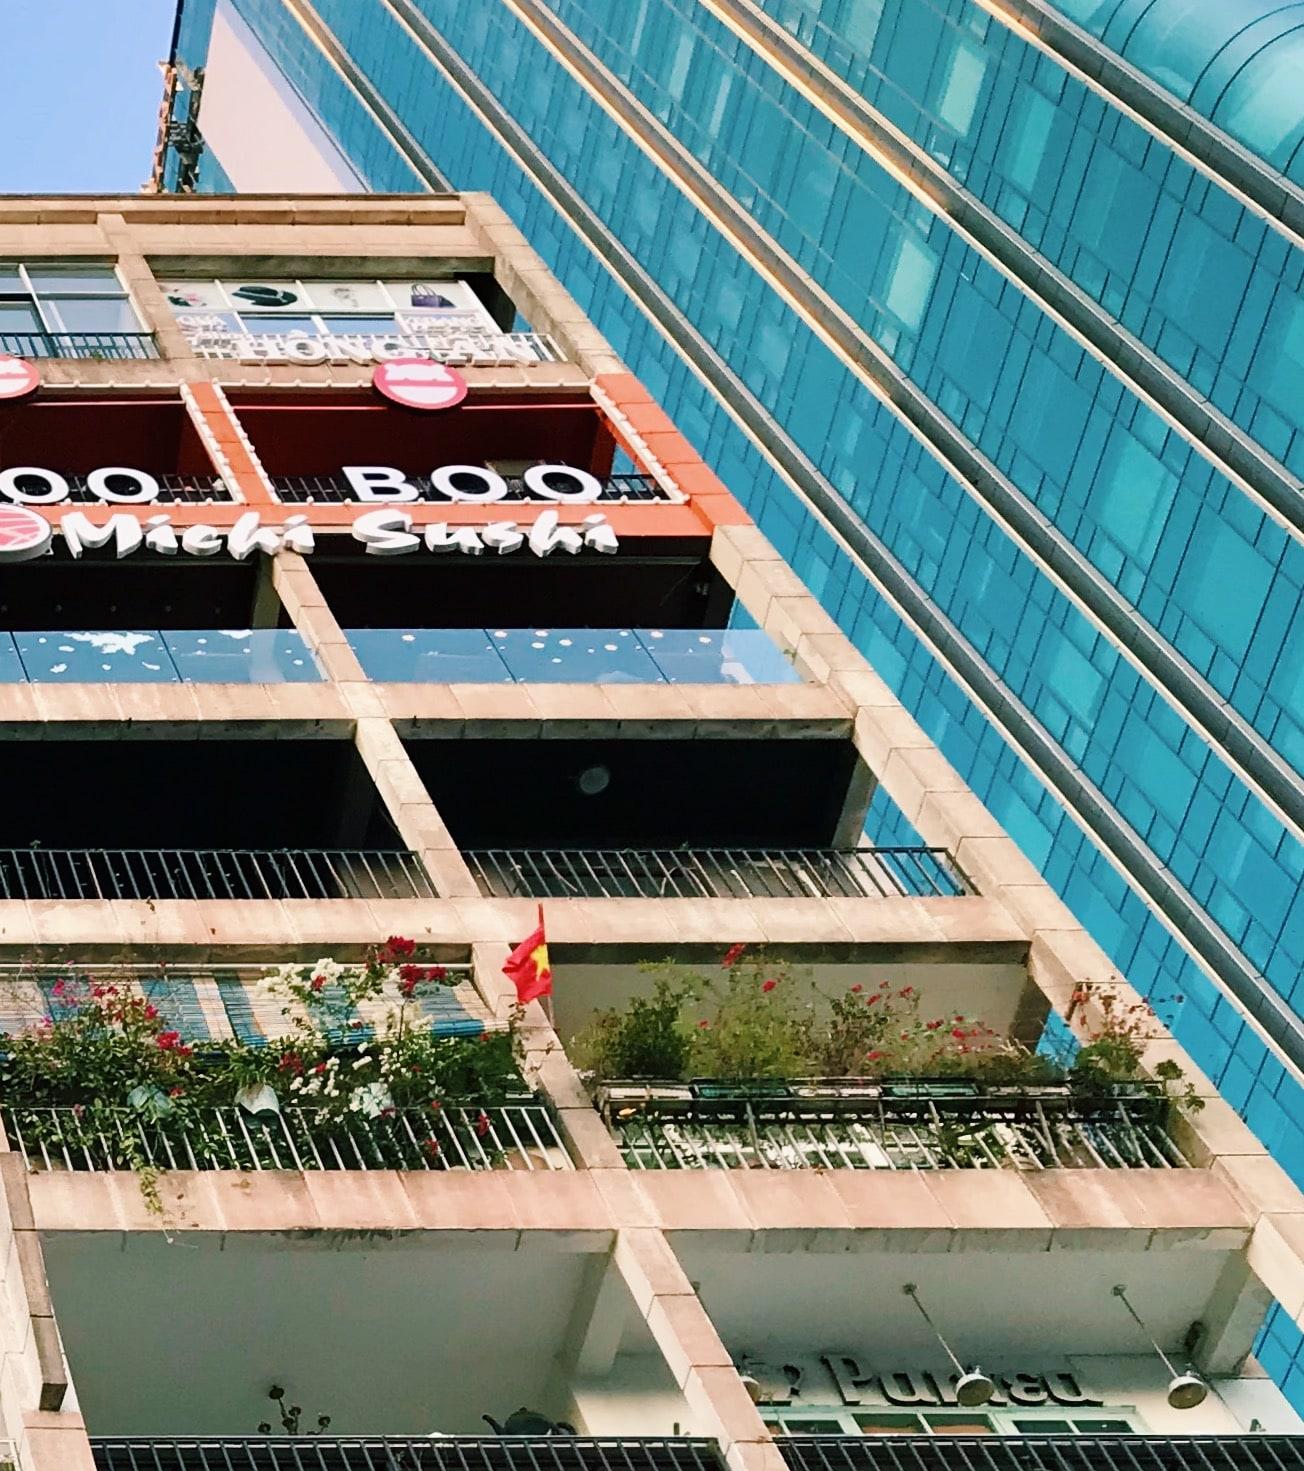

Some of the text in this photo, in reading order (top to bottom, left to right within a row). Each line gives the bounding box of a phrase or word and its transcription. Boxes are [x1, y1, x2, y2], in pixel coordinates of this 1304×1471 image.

[341, 464, 603, 504] BOO
[60, 508, 618, 560] Michi Sushi
